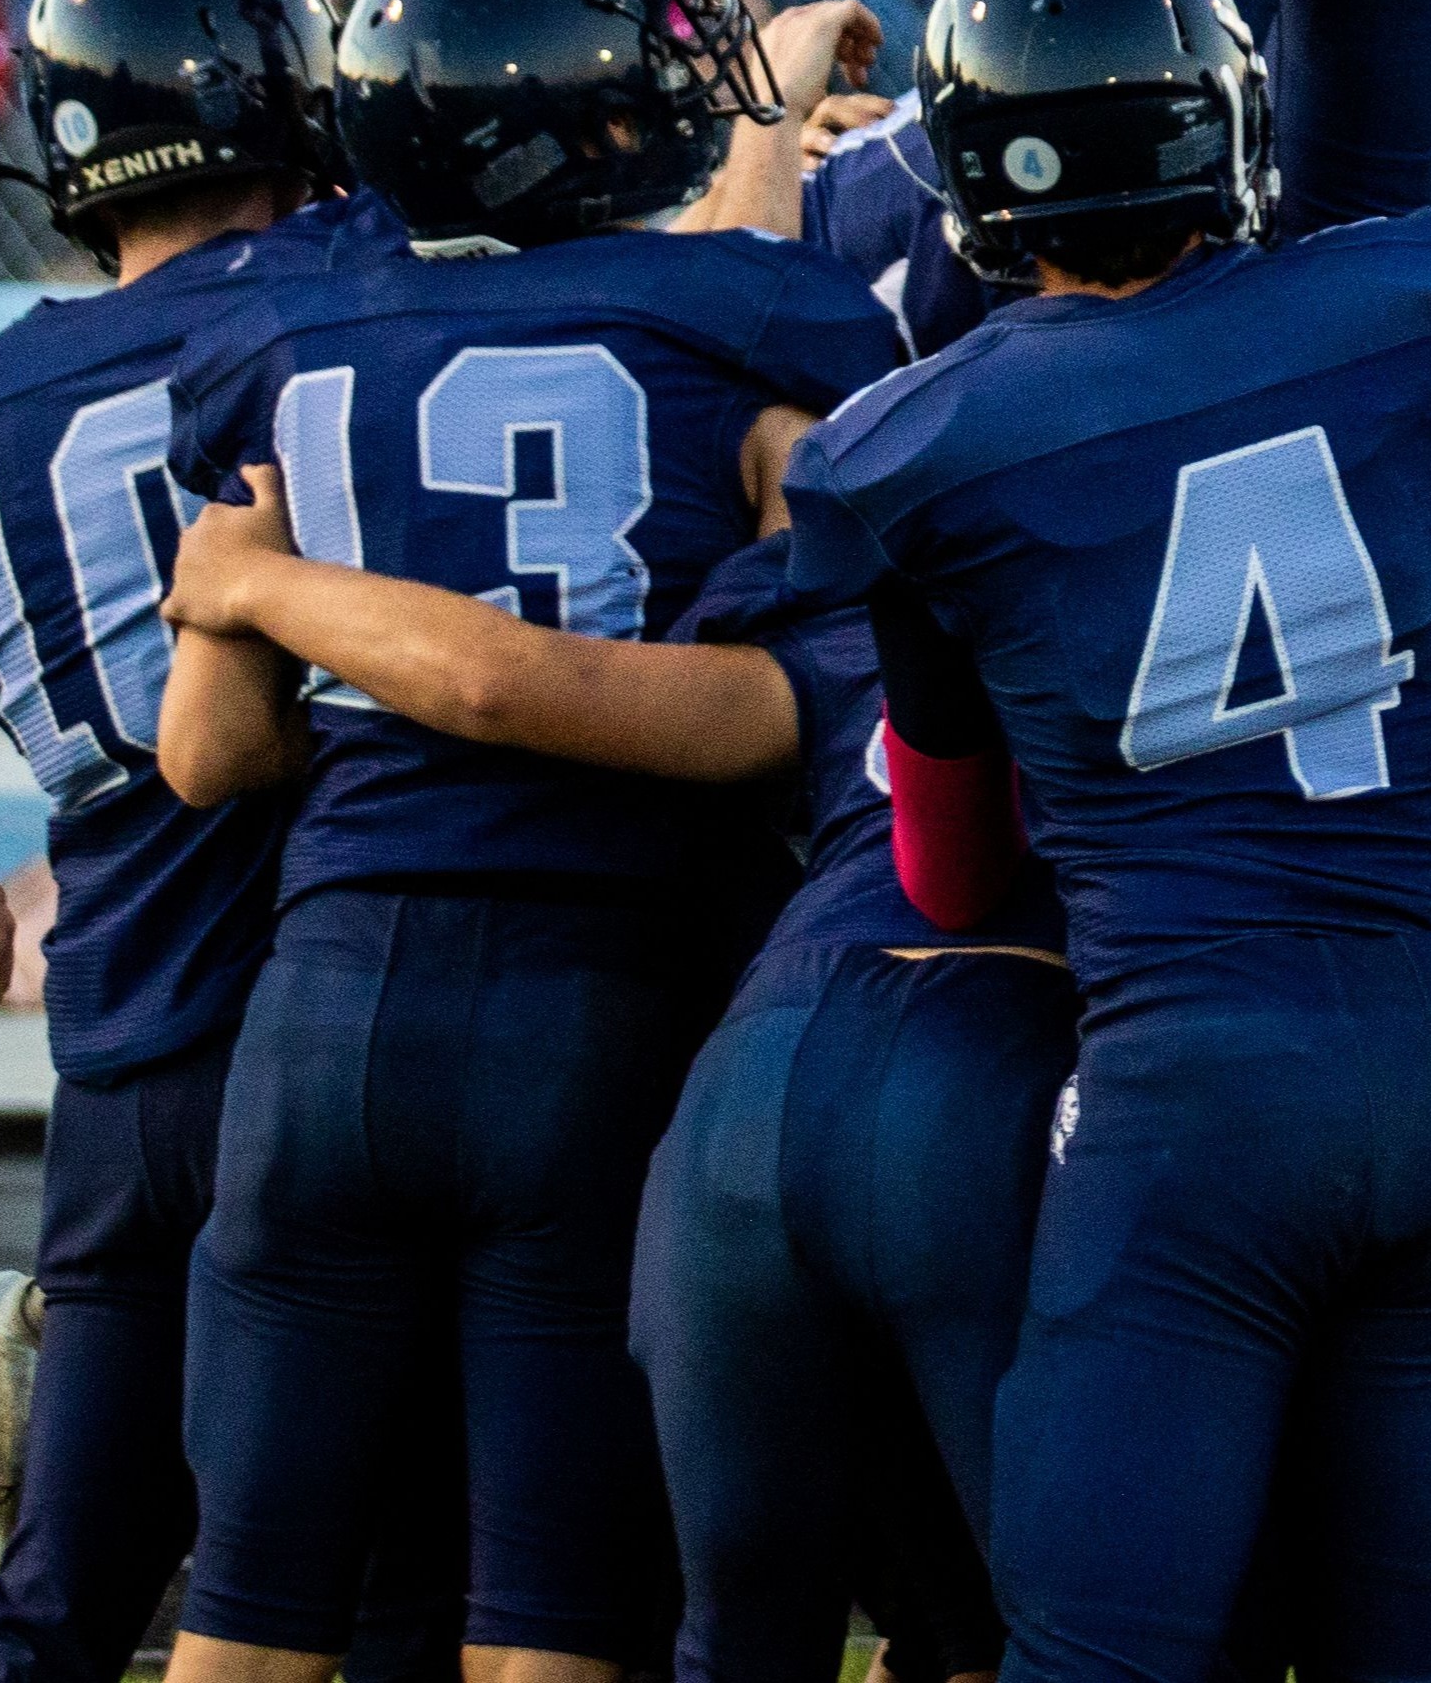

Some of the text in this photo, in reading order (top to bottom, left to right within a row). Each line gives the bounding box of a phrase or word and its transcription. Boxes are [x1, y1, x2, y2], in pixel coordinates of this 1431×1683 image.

[80, 139, 205, 192] XENITH
[1023, 148, 1045, 179] 4
[272, 342, 653, 711] 13
[1119, 424, 1416, 801] 4
